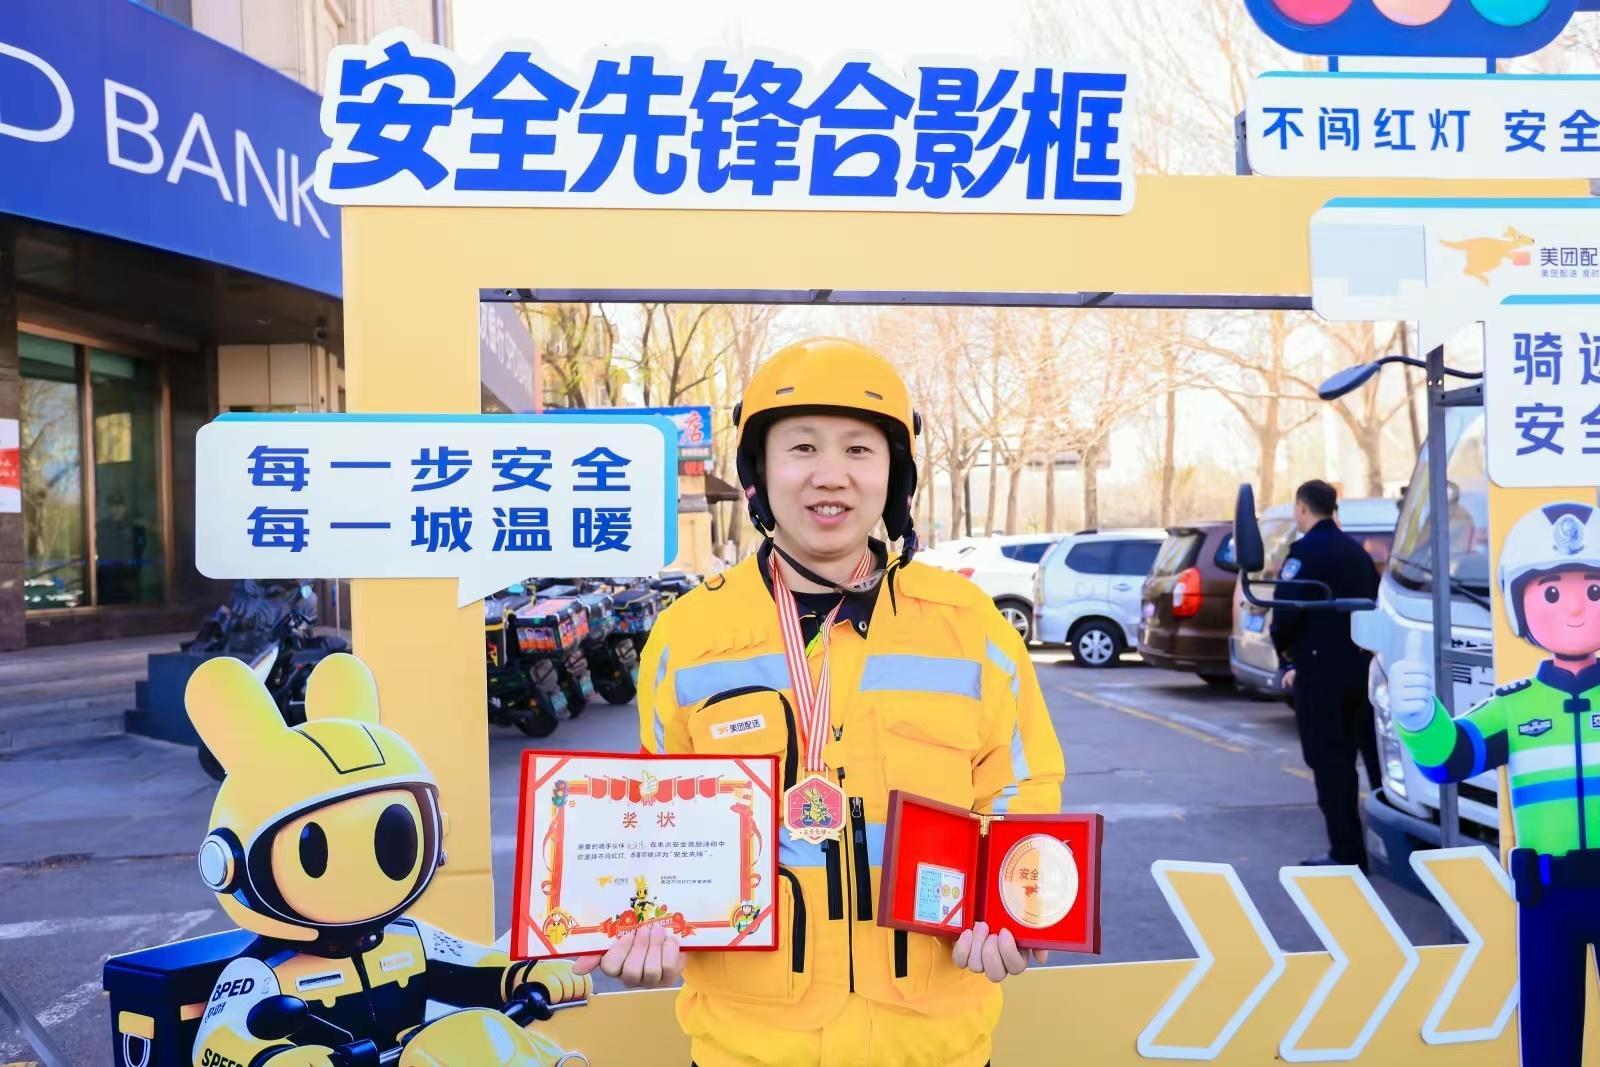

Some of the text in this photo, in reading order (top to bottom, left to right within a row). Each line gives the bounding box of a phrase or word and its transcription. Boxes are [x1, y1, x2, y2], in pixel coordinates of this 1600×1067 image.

[329, 41, 1127, 200] 安全先锋合影框
[1262, 107, 1600, 152] 不闯红灯 安全
[104, 78, 330, 239] BANK
[246, 445, 633, 492] 每一步安全
[246, 506, 633, 553] 每一城温暖
[622, 811, 676, 829] 奖状
